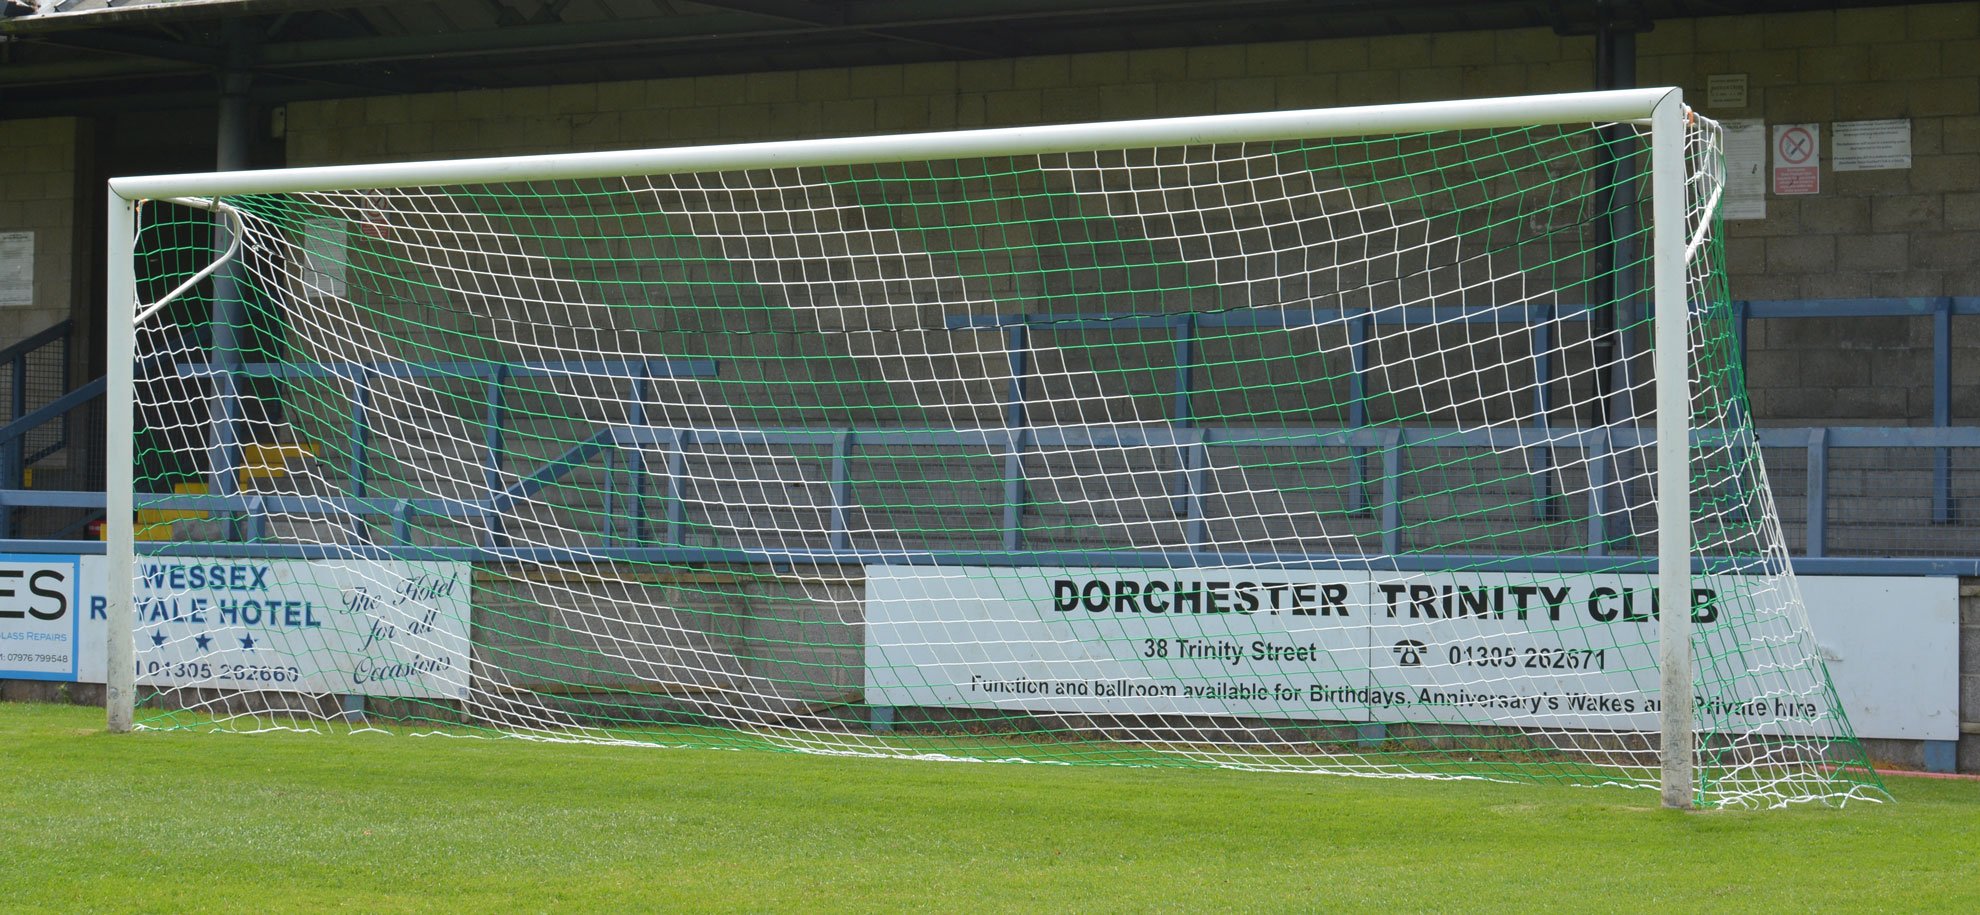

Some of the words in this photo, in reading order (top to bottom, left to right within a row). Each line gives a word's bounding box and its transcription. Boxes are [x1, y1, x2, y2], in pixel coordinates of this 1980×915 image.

[142, 564, 269, 591] WESSEX
[0, 570, 67, 621] ES
[340, 586, 382, 615] The
[392, 571, 458, 606] Hotel
[1053, 579, 1350, 617] DORCHESTER
[1377, 584, 1572, 621] TRINITY
[90, 595, 208, 624] RYALE
[219, 599, 321, 627] HOTEL
[0, 631, 25, 641] LASS
[26, 631, 68, 642] REPAIRS
[357, 615, 395, 652] for
[406, 608, 439, 636] all
[8, 653, 34, 663] 07976
[36, 654, 68, 663] 799548
[1144, 638, 1168, 659] 38
[1175, 639, 1244, 666] Trinity
[1251, 641, 1317, 662] Street
[1449, 645, 1517, 667] 01305
[1524, 648, 1606, 671] 262671
[149, 660, 212, 679] 01305
[219, 664, 299, 683] 262660
[353, 654, 451, 684] Occasions
[971, 675, 1049, 694] Function
[1055, 679, 1088, 696] and
[1094, 680, 1177, 698] ballroom
[1183, 683, 1268, 701] available
[1274, 685, 1301, 702] for
[1310, 684, 1411, 709] Birthdays,
[1418, 687, 1559, 714] Anniversary's
[1567, 692, 1635, 713] Wakes
[1692, 696, 1767, 718] Private
[1775, 697, 1817, 718] hire
